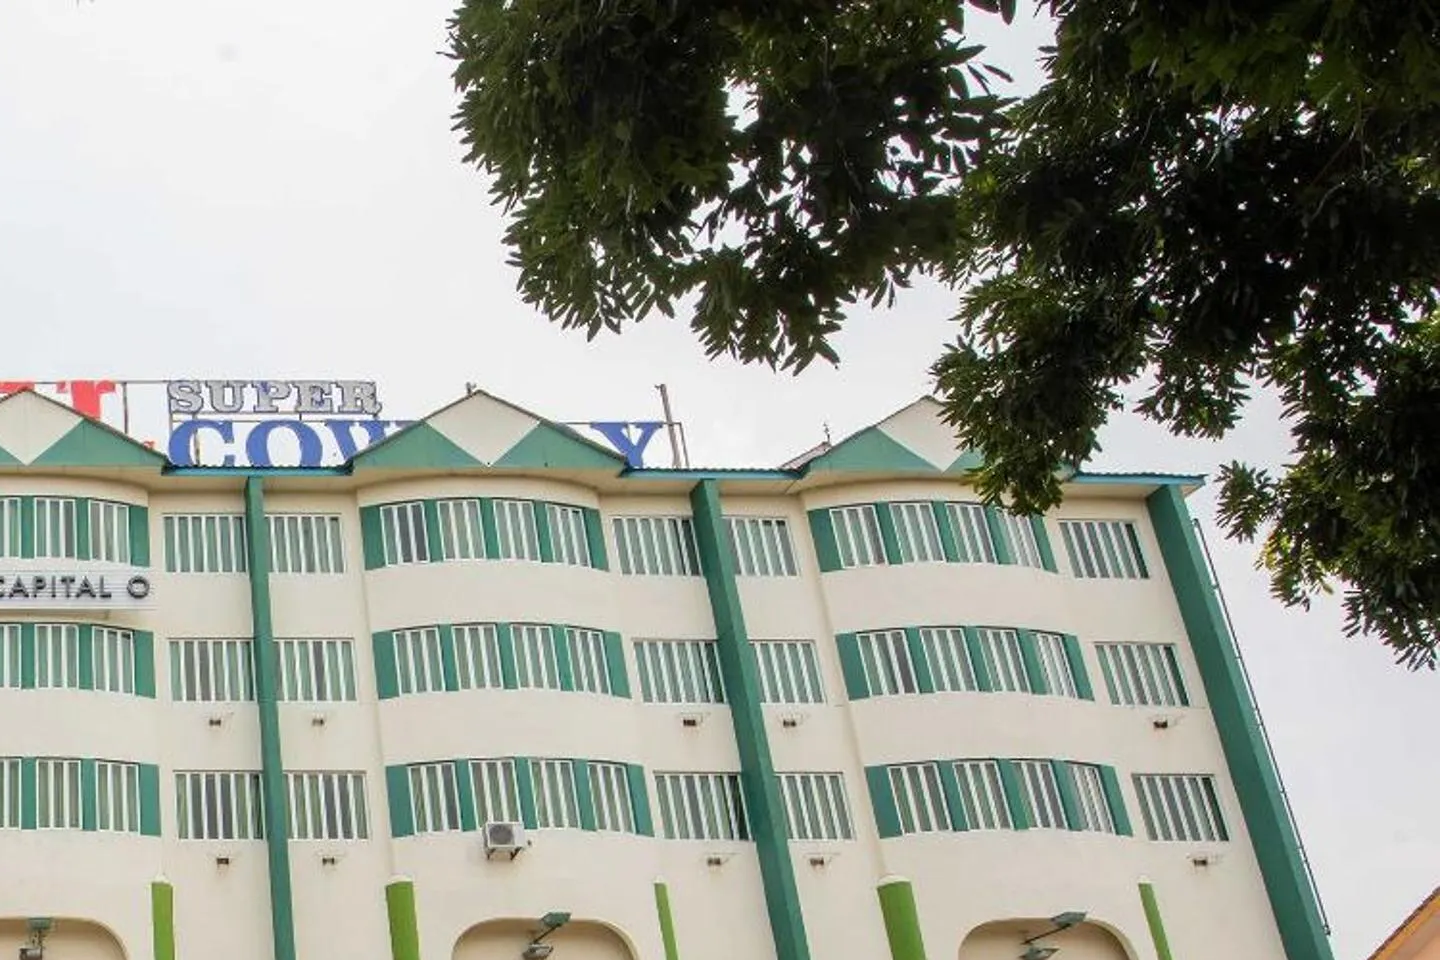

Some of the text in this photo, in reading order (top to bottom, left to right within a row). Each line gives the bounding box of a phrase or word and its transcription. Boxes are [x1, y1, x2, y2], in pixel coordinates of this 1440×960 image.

[167, 379, 382, 416] SUPER
[168, 420, 663, 468] COY
[126, 575, 151, 599] O
